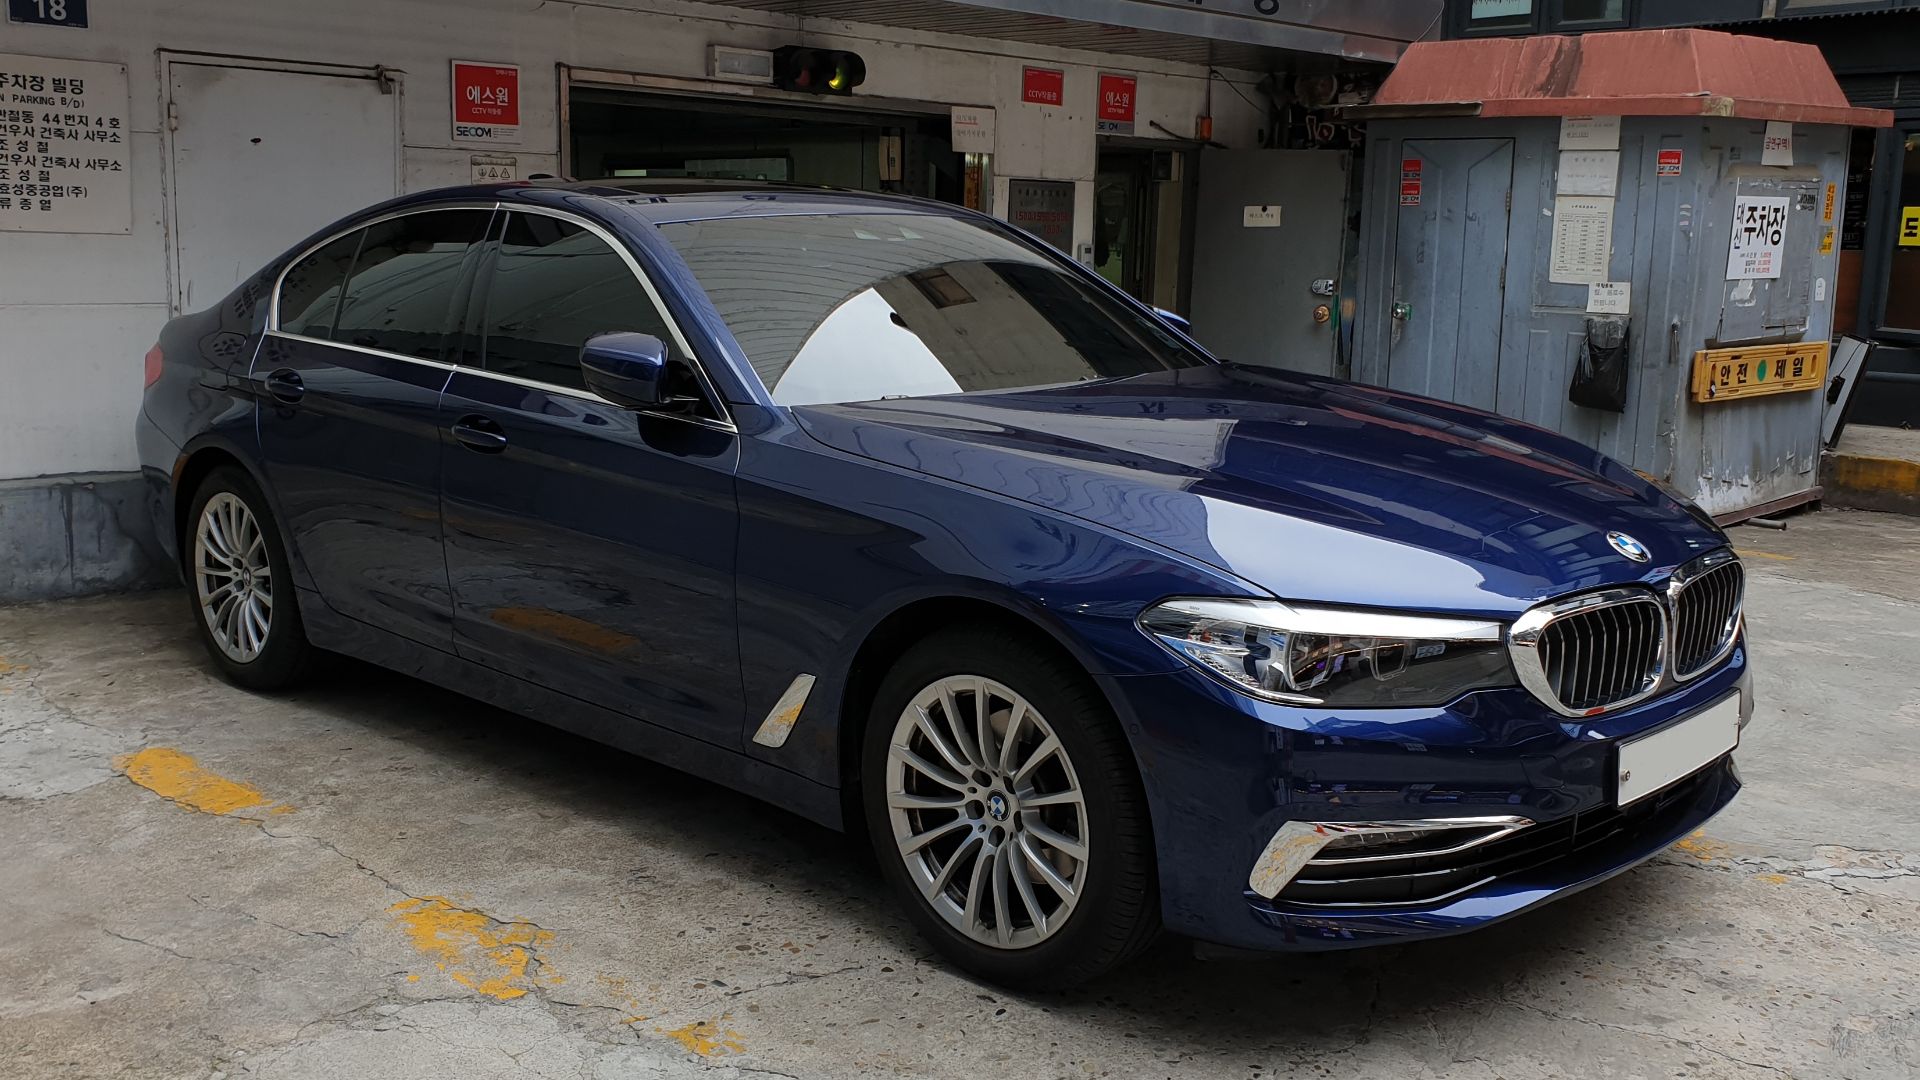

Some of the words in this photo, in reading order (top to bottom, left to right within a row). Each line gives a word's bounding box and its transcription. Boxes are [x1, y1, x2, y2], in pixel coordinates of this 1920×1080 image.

[52, 77, 84, 95] 빌딩
[12, 94, 55, 106] PARKING
[466, 85, 509, 106] 에스원
[1105, 91, 1129, 107] 에스원
[471, 107, 487, 115] CCTV
[456, 126, 492, 138] SECOM
[1097, 121, 1119, 131] SEOM
[84, 129, 121, 143] 사무소
[85, 158, 122, 171] 사무소
[1744, 205, 1786, 246] 주차장
